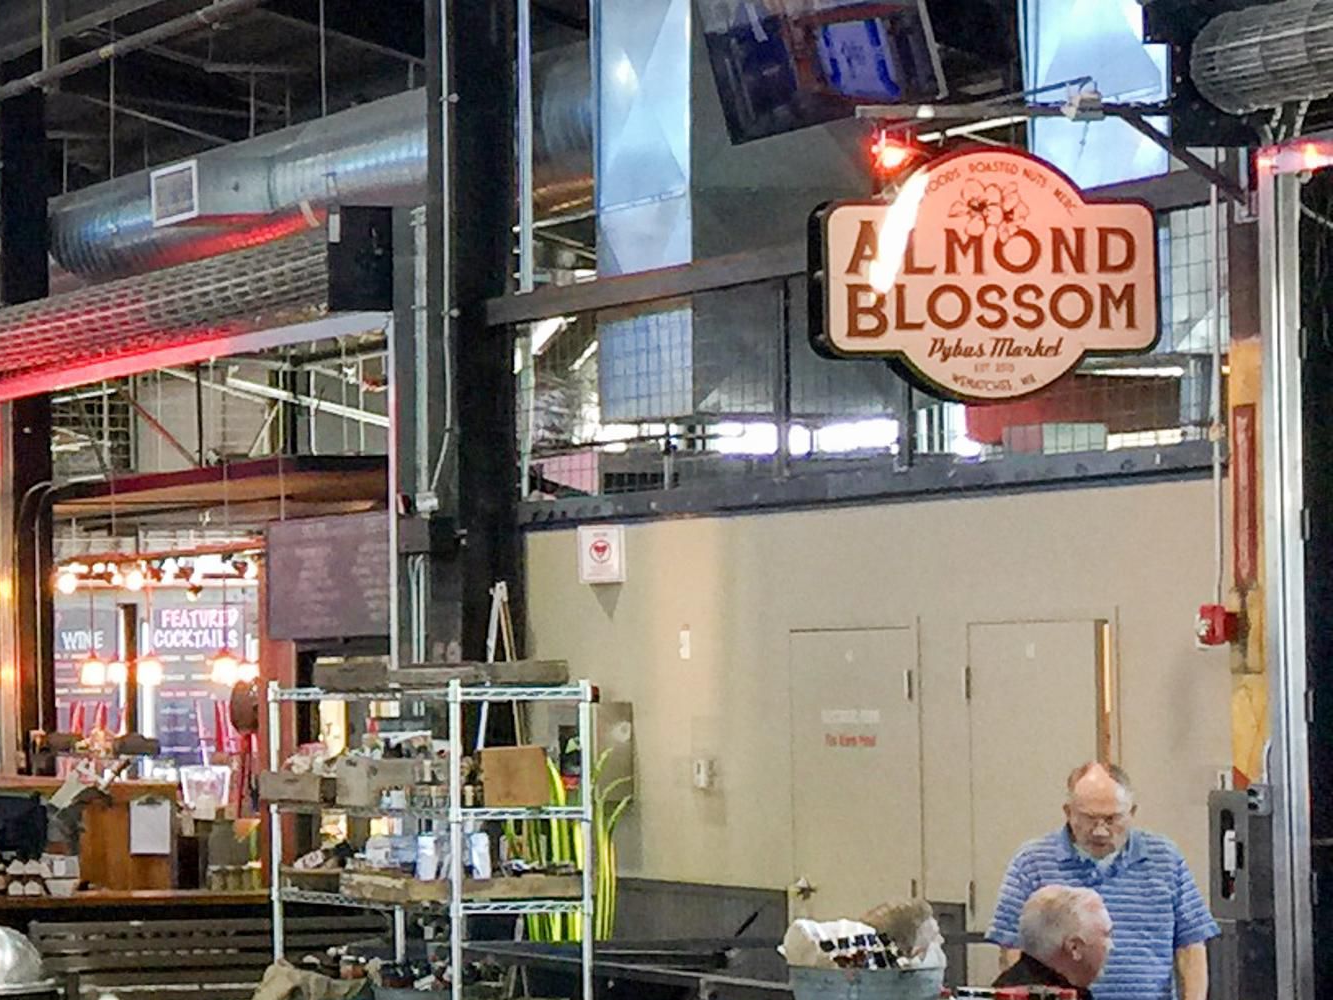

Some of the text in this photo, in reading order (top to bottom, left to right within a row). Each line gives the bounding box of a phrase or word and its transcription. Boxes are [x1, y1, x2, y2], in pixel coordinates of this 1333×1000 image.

[925, 168, 961, 194] OODS
[969, 161, 1019, 175] ROASTED
[1023, 168, 1049, 189] NUTS
[845, 220, 1137, 276] ALMOND
[845, 282, 1138, 338] BLOSSOM
[928, 336, 1064, 362] Pybus Market
[61, 631, 105, 650] WINE
[154, 629, 239, 649] COCKTAILS
